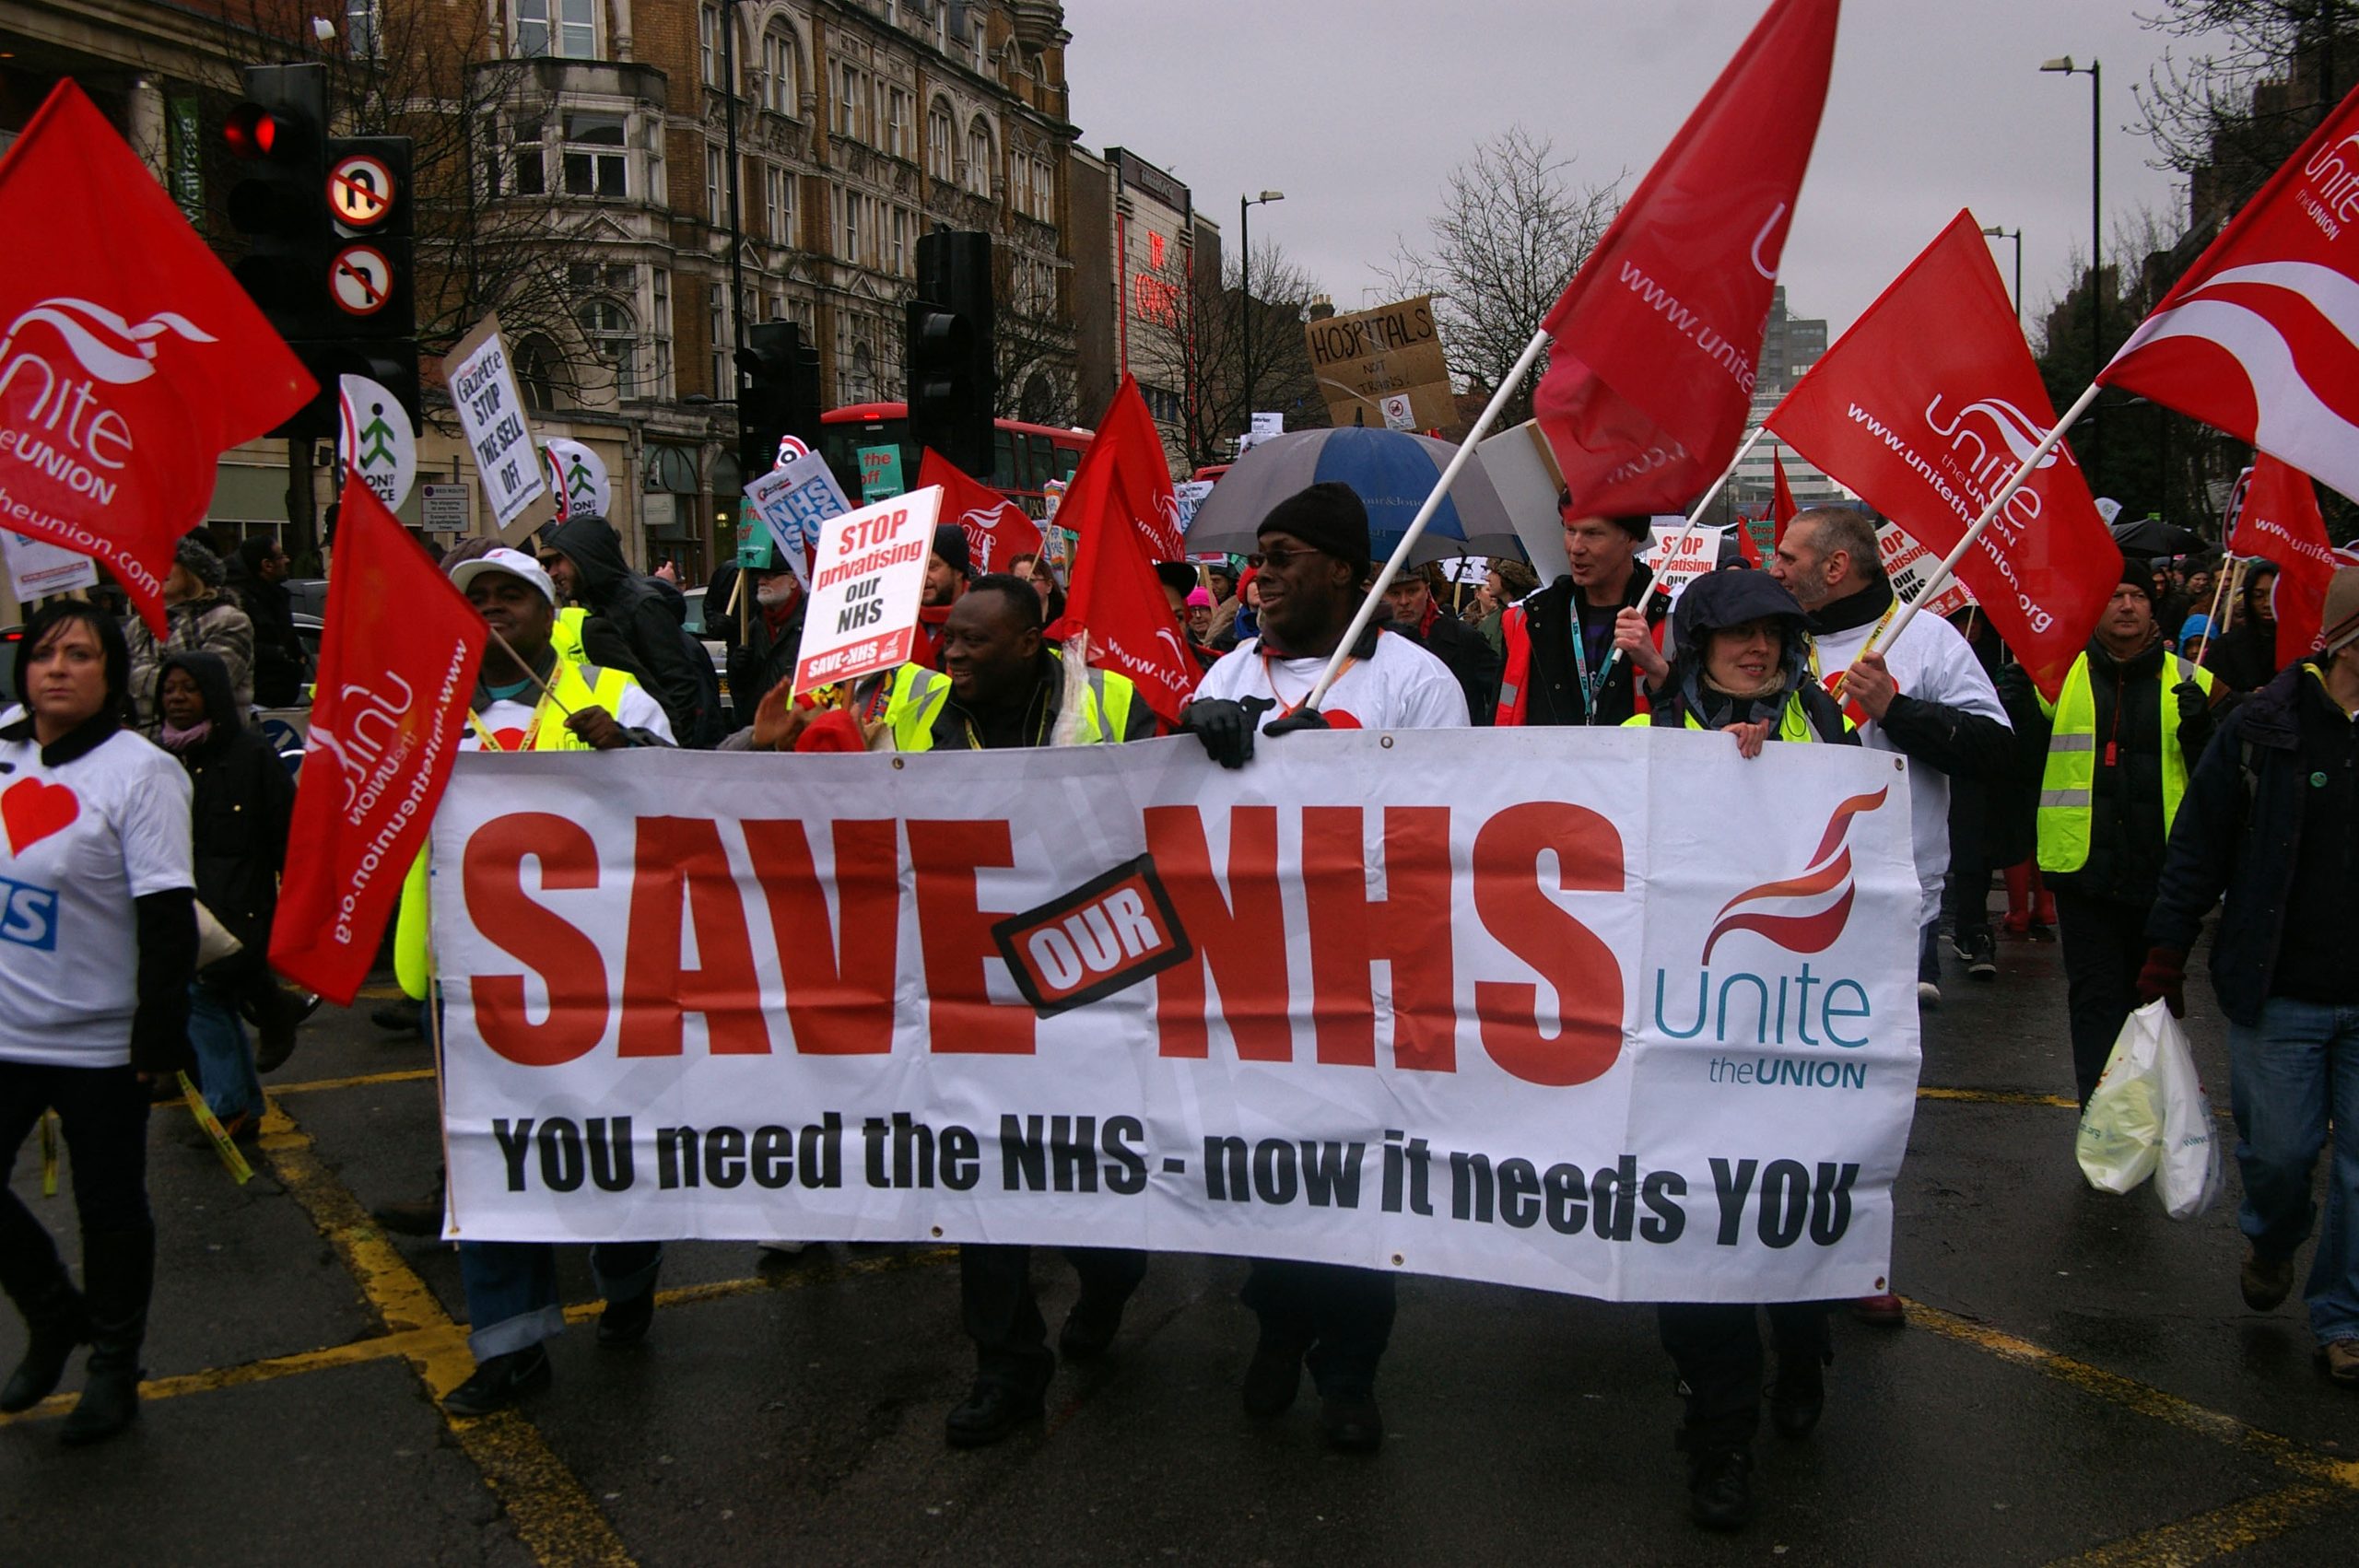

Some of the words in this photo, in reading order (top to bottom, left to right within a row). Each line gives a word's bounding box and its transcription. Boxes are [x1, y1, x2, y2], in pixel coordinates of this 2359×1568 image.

[1311, 308, 1432, 364] HOSPITALS
[457, 350, 502, 404] Gazette
[1363, 359, 1386, 374] NOT
[472, 382, 500, 427] STOP
[477, 433, 500, 469] THE
[498, 412, 523, 451] SELL
[864, 452, 891, 467] the
[1925, 393, 2042, 530] unite
[500, 459, 522, 496] OFF
[1942, 454, 2016, 547] theUNON
[769, 479, 833, 532] NHS
[839, 509, 908, 556] STOP
[1661, 535, 1703, 555] SOP
[816, 539, 923, 591] privatising
[1893, 568, 1917, 589] our
[845, 576, 882, 604] our
[837, 598, 884, 635] NHS
[808, 651, 843, 678] SAVE
[463, 812, 1036, 1066] SAVE
[1027, 886, 1163, 990] OUR
[1144, 801, 1625, 1086] NHS
[1654, 963, 1871, 1048] unite
[1709, 1057, 1867, 1089] theUNION
[493, 1116, 635, 1192] YOU
[657, 1112, 842, 1190] need
[862, 1112, 980, 1190] the
[1000, 1114, 1148, 1195] NHS
[1204, 1134, 1365, 1208] now
[1381, 1129, 1432, 1216] it
[1449, 1153, 1687, 1244] needs
[1708, 1157, 1860, 1249] YOU
